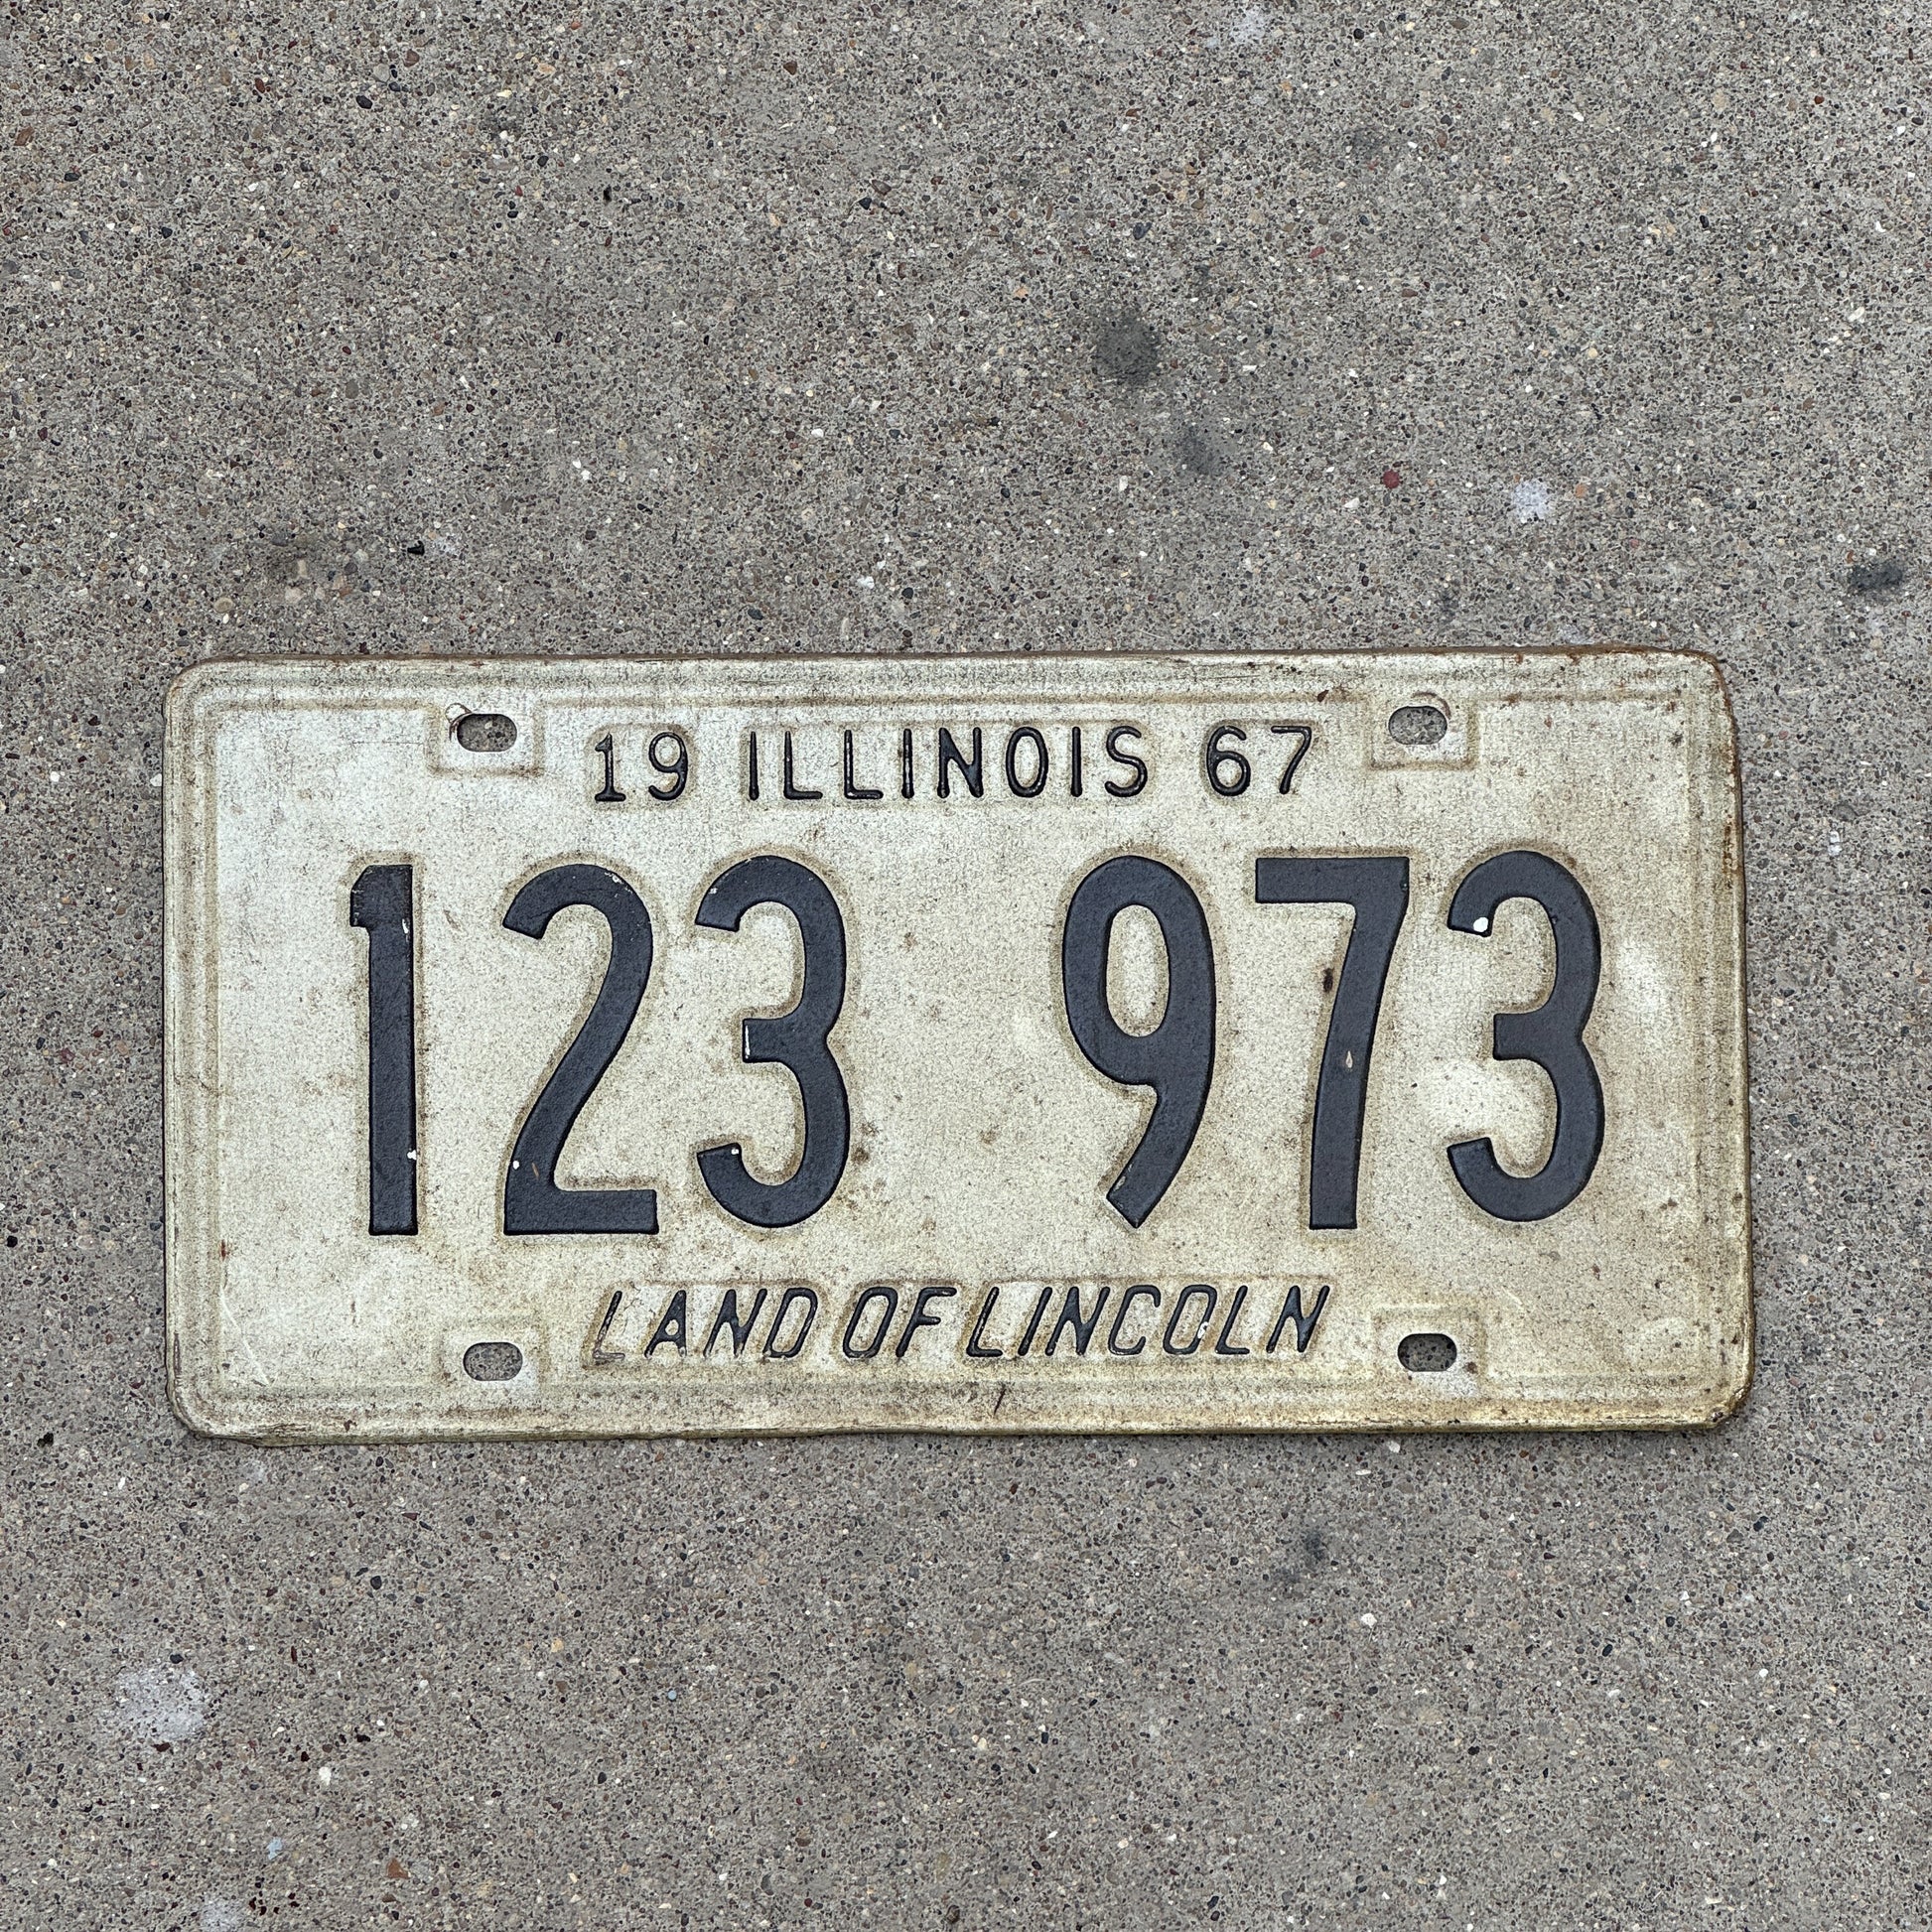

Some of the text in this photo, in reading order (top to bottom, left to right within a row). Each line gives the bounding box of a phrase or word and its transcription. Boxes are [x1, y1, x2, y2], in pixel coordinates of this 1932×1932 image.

[594, 725, 1312, 804] 19 ILLINOIS 67
[348, 849, 1606, 1237] 123 973
[595, 1282, 1330, 1361] LAND OF LINCOLN
